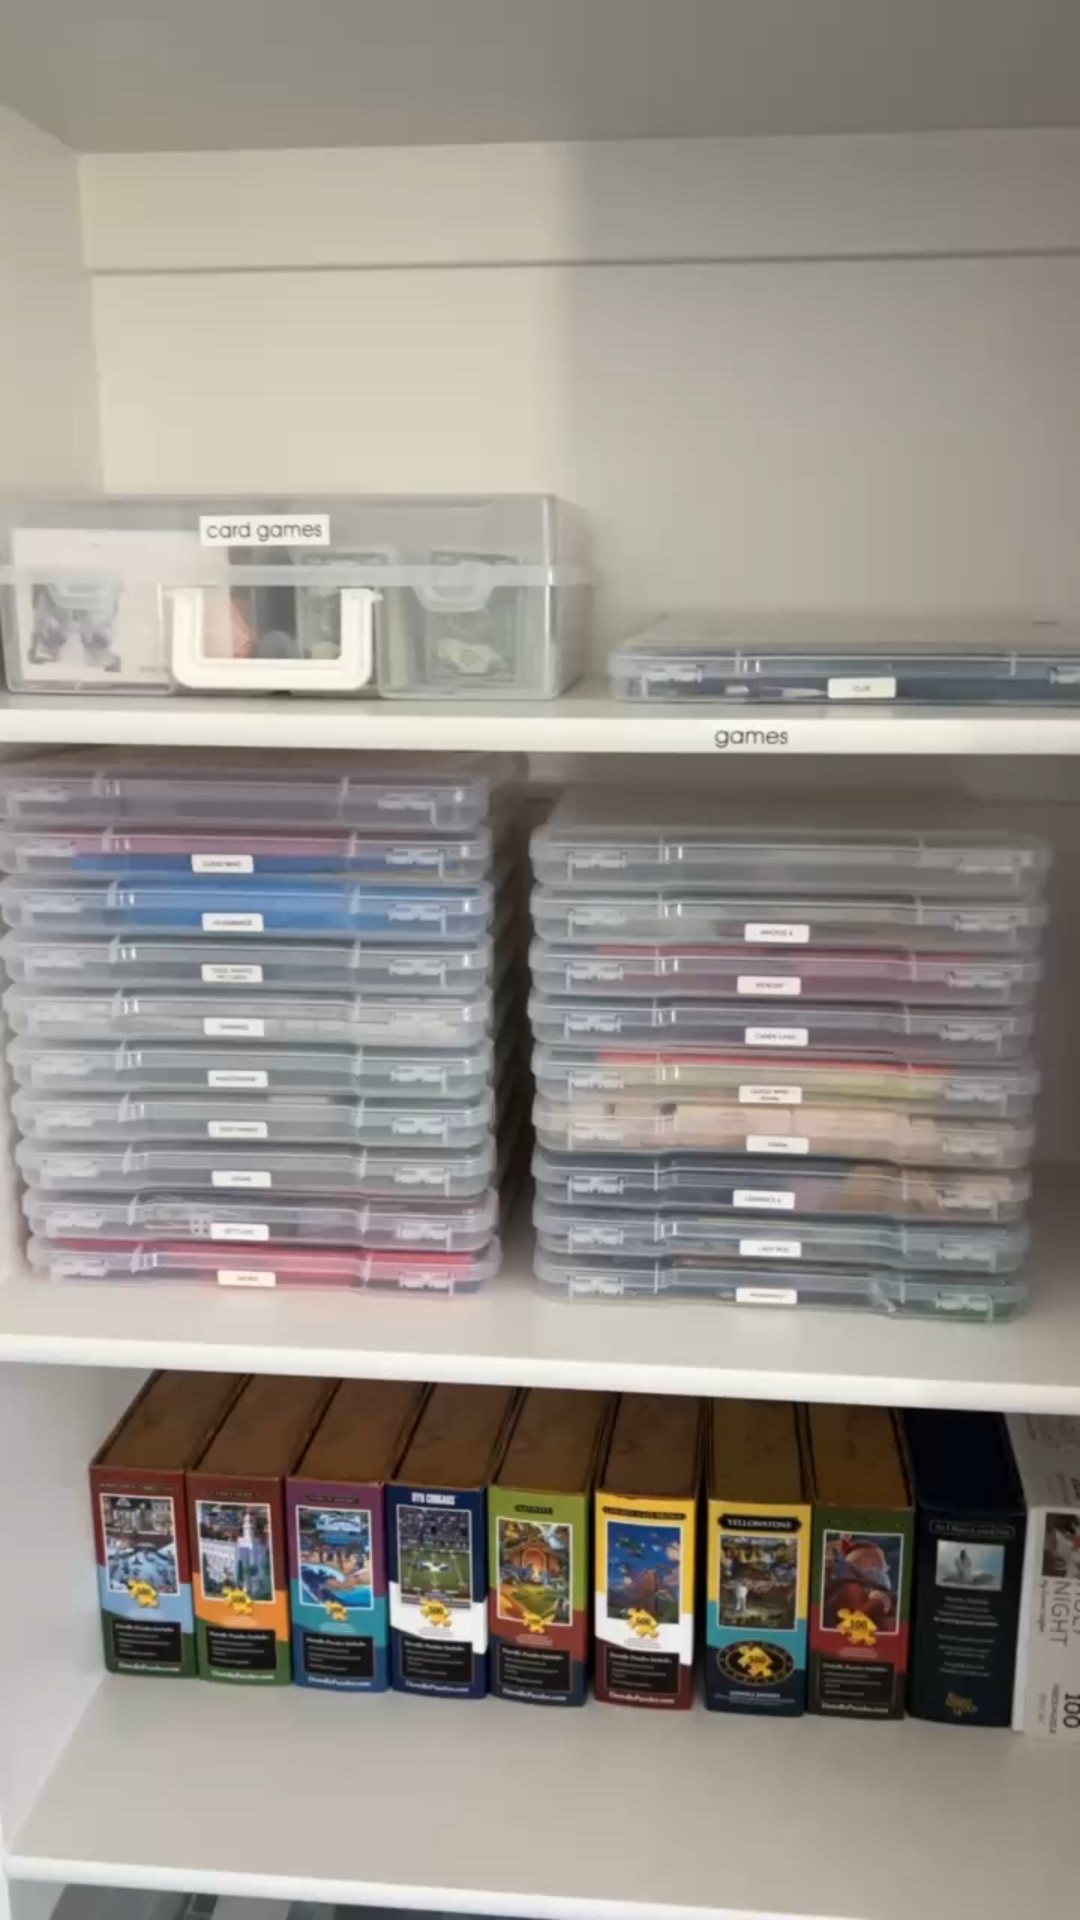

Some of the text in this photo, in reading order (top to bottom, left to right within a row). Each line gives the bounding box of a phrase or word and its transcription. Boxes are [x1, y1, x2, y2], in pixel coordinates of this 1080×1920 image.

[206, 521, 322, 542] card games
[714, 730, 788, 749] games
[726, 1518, 792, 1530] YELLOWSTONE
[1049, 1580, 1072, 1647] NIGHT
[1062, 1691, 1080, 1729] 100
